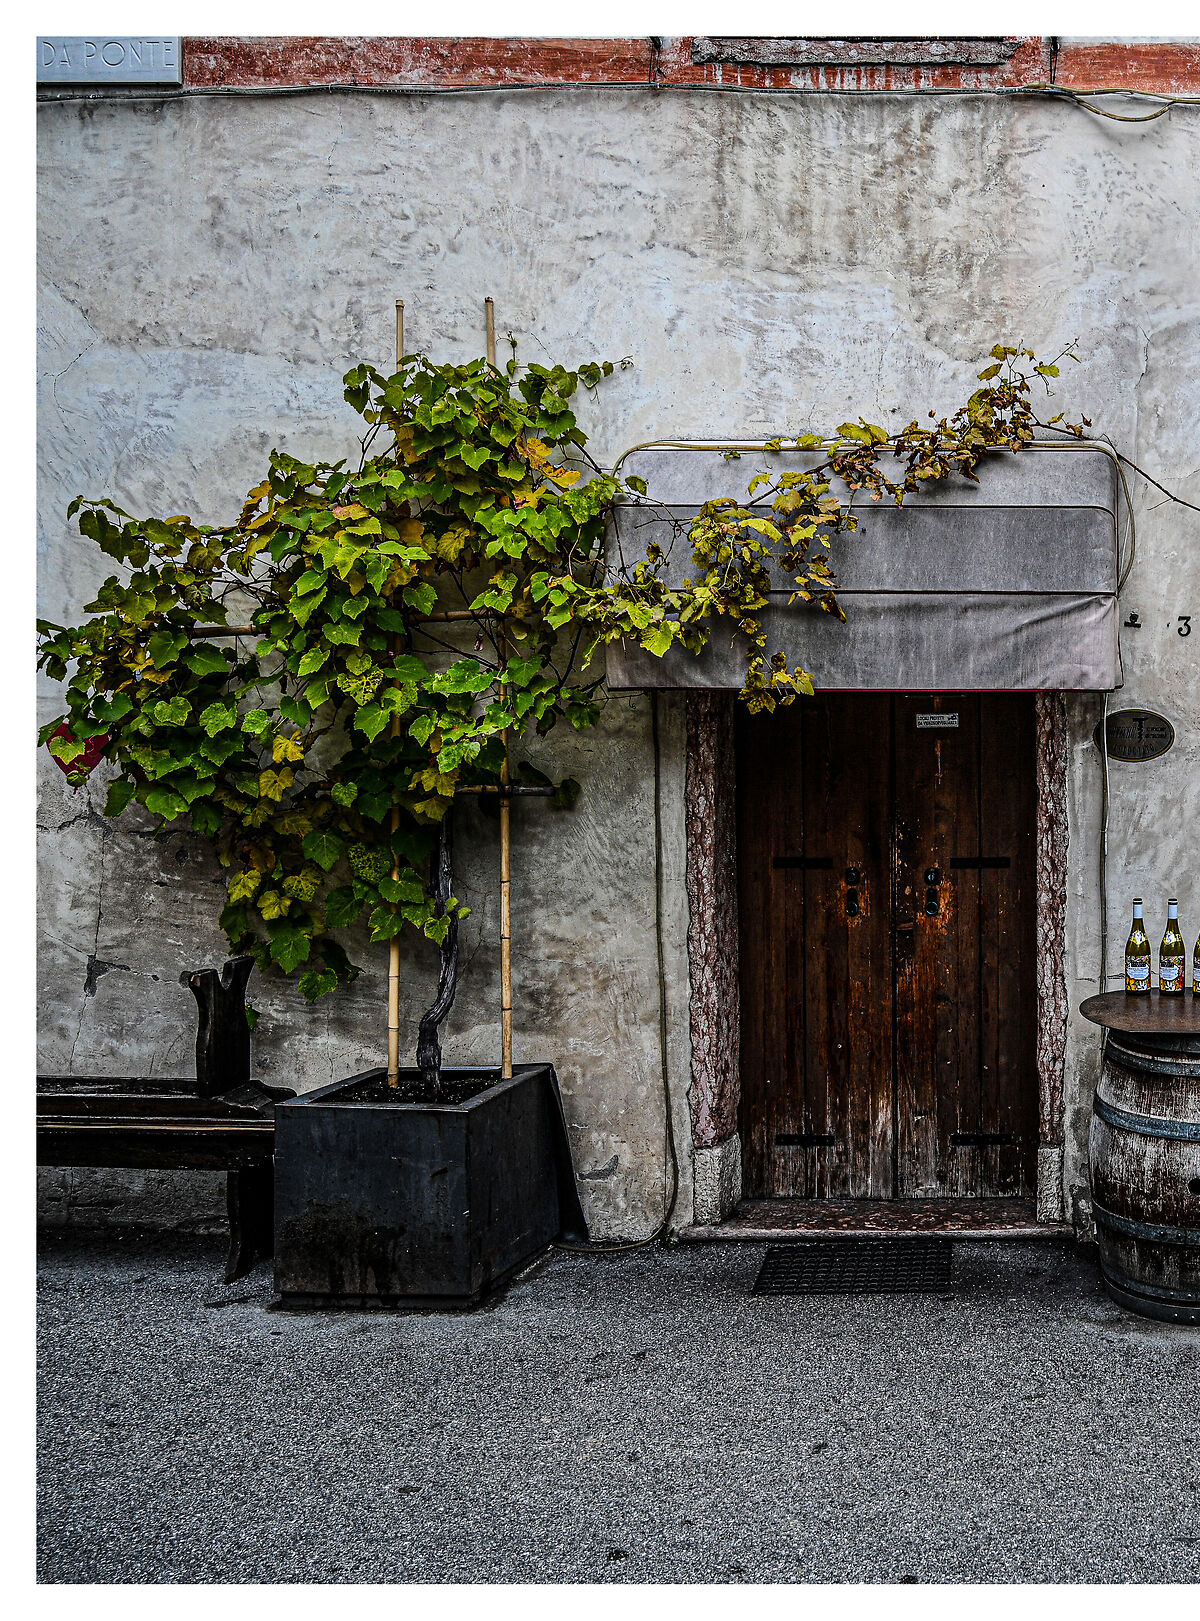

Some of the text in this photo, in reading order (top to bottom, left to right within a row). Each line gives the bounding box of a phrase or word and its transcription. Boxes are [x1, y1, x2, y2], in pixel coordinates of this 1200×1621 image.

[42, 41, 175, 68] DA PONTE
[1177, 615, 1192, 637] 3
